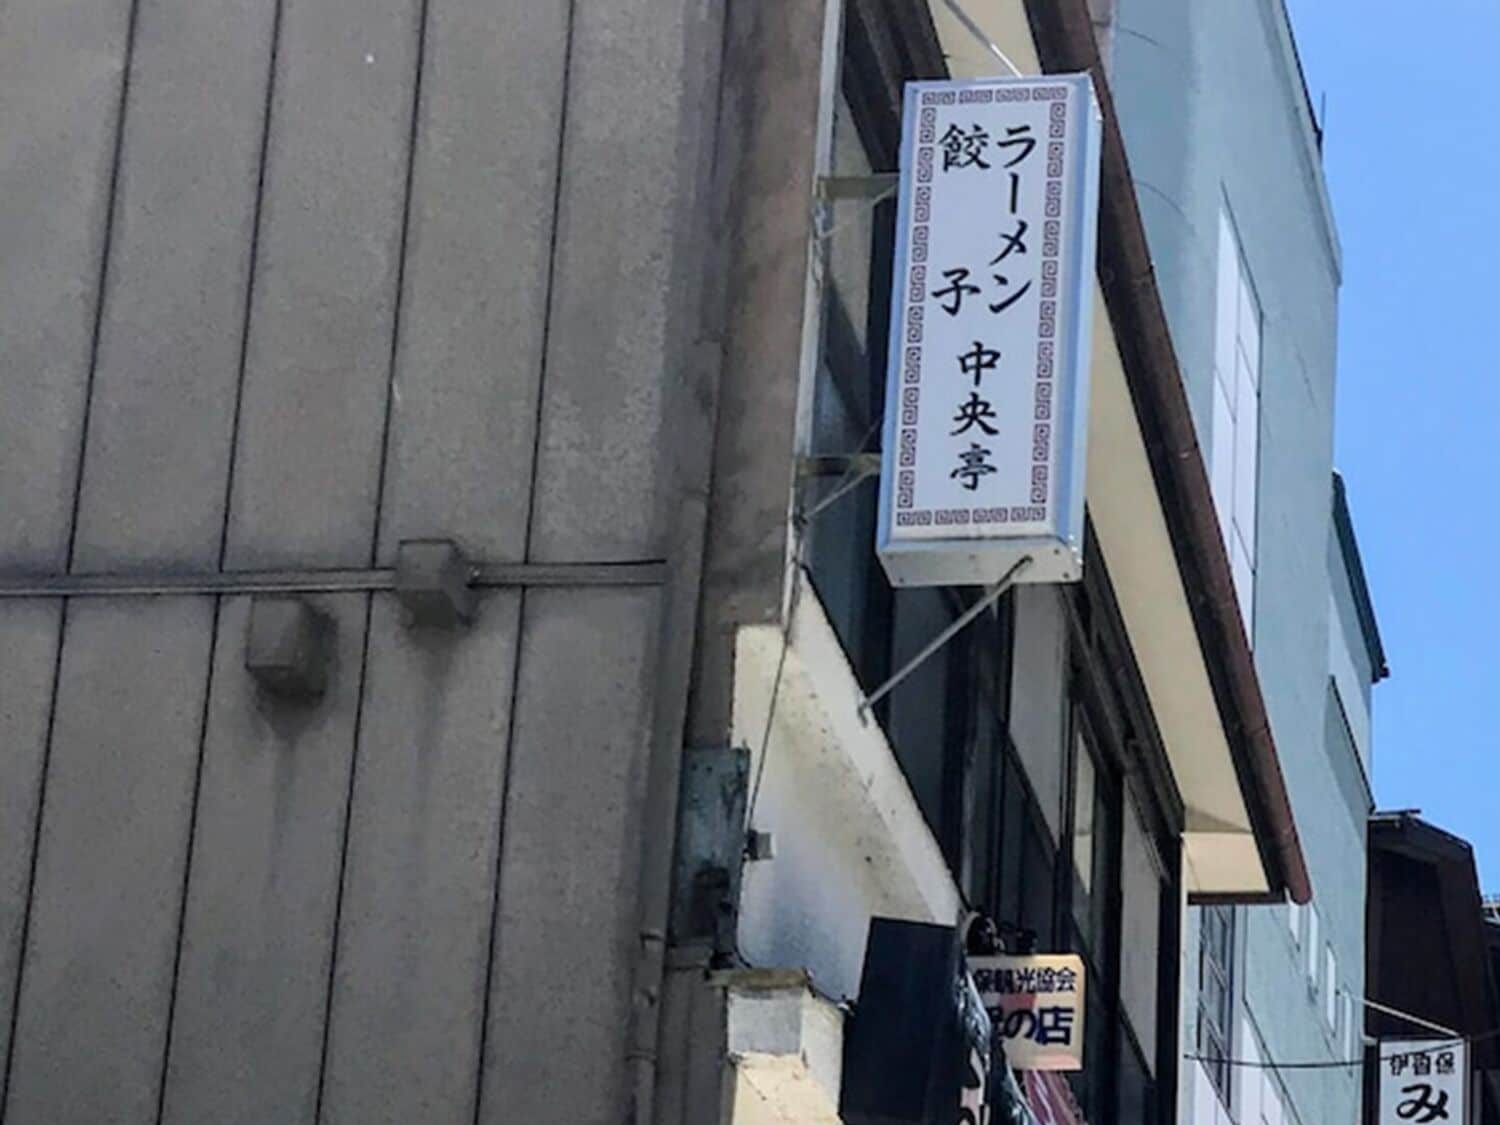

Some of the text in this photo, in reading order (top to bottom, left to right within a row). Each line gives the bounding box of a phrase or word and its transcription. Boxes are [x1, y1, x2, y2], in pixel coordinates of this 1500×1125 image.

[931, 122, 992, 317] 餃子
[988, 123, 1038, 314] ラーメン
[949, 341, 1002, 492] 中央亭
[1389, 1051, 1457, 1076] 伊香保
